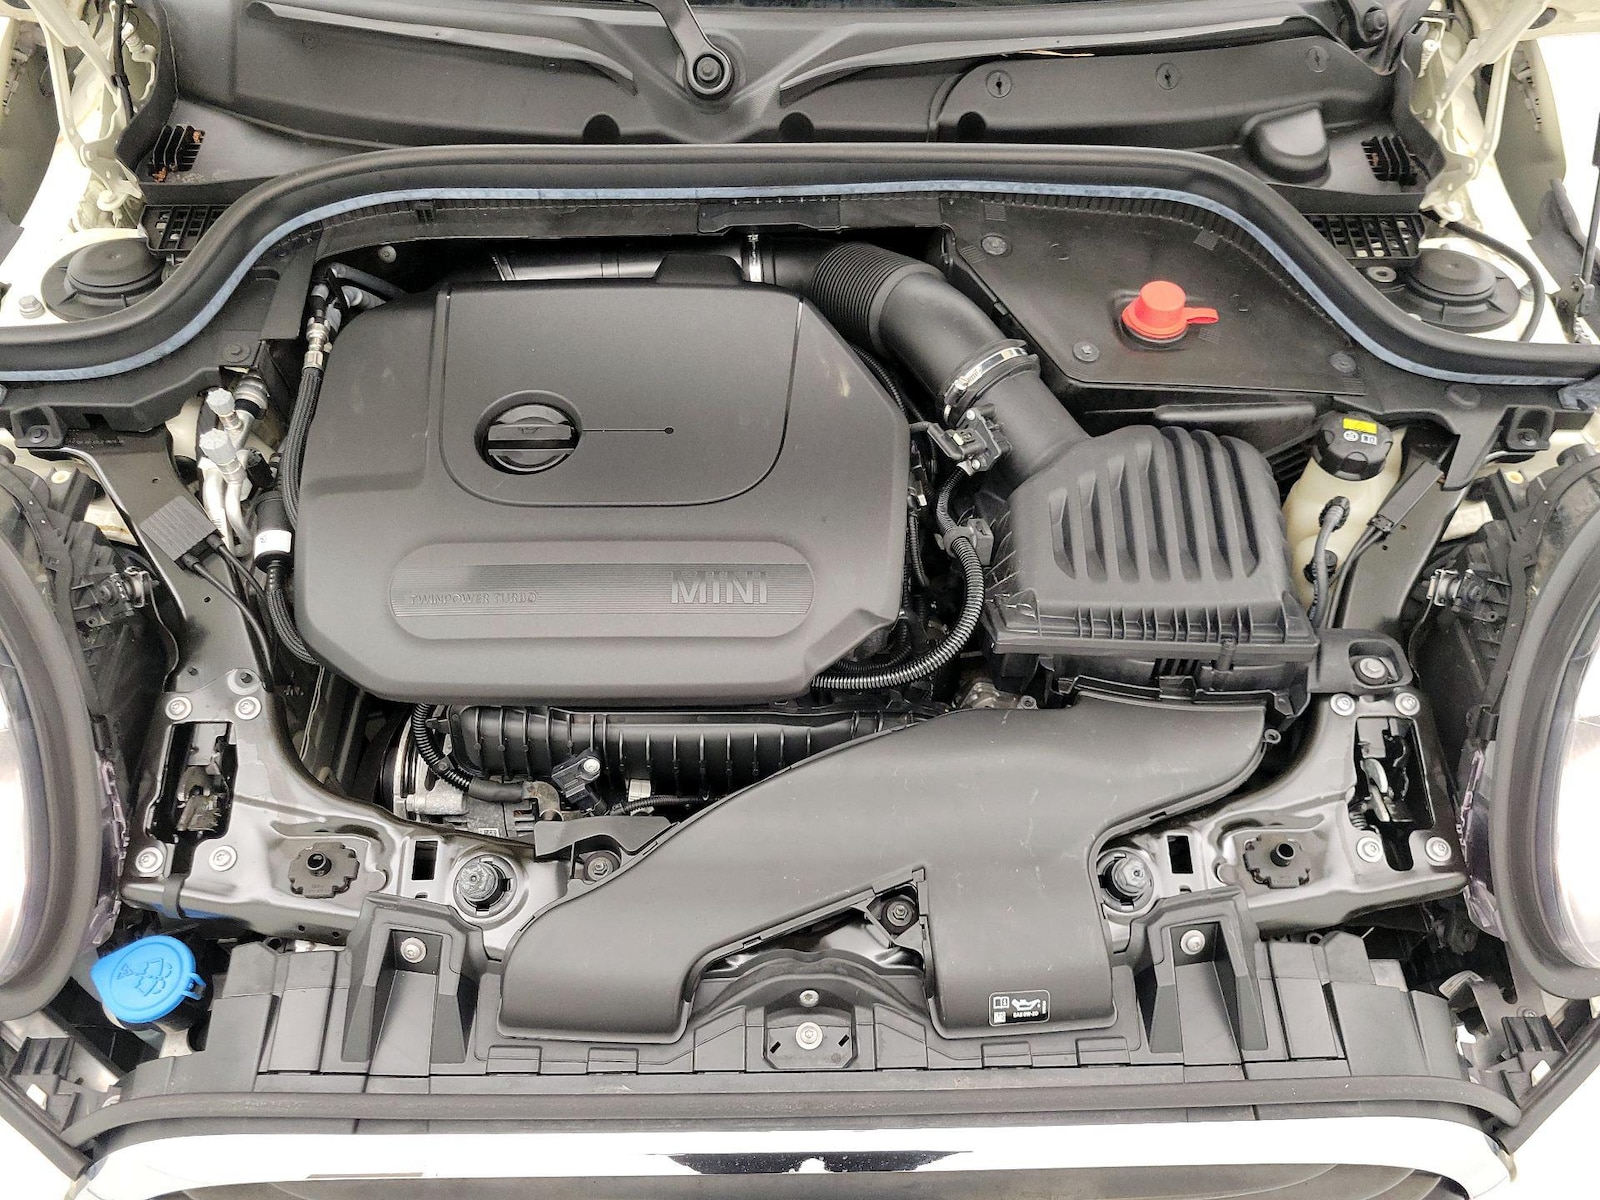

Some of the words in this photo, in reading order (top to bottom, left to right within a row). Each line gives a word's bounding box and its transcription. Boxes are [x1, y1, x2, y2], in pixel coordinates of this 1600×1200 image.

[410, 592, 489, 605] TWINPOWER
[494, 590, 537, 603] TURBO
[671, 571, 767, 604] MINI
